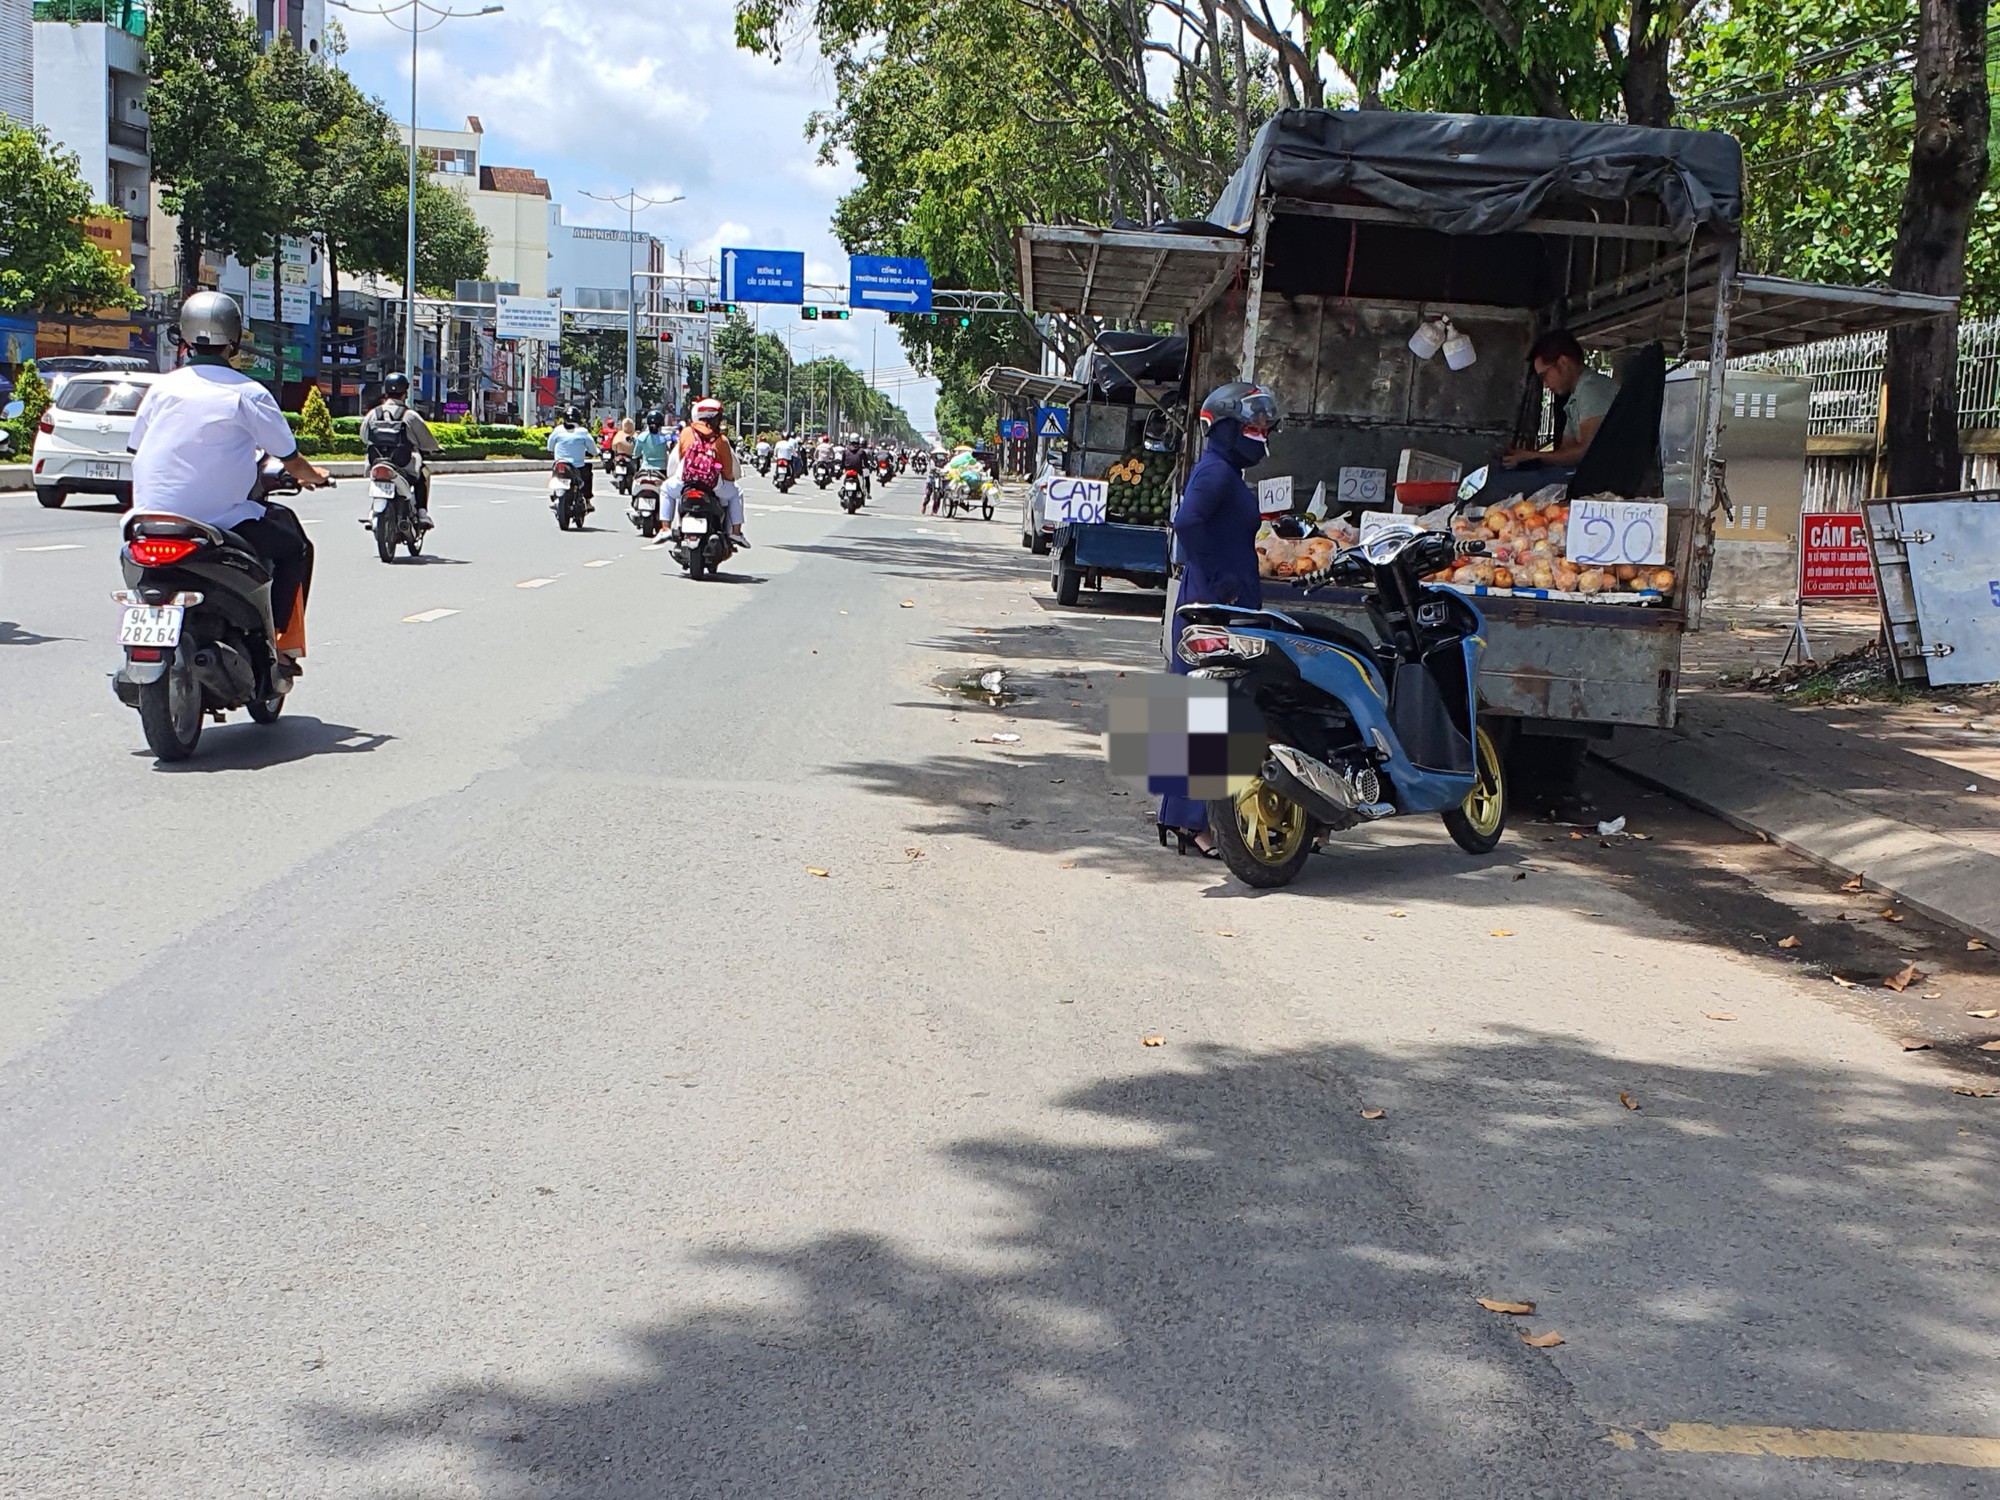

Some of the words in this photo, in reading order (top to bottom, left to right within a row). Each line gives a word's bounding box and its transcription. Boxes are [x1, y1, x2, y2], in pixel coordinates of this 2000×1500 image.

[695, 301, 703, 311] 9
[809, 308, 816, 318] 9
[931, 314, 938, 325] 9
[1049, 479, 1102, 501] CAM
[1061, 500, 1107, 524] 10K
[1575, 518, 1655, 564] 20
[1810, 518, 1847, 548] CẤM
[1818, 582, 1844, 591] camera
[122, 626, 175, 643] 282.64
